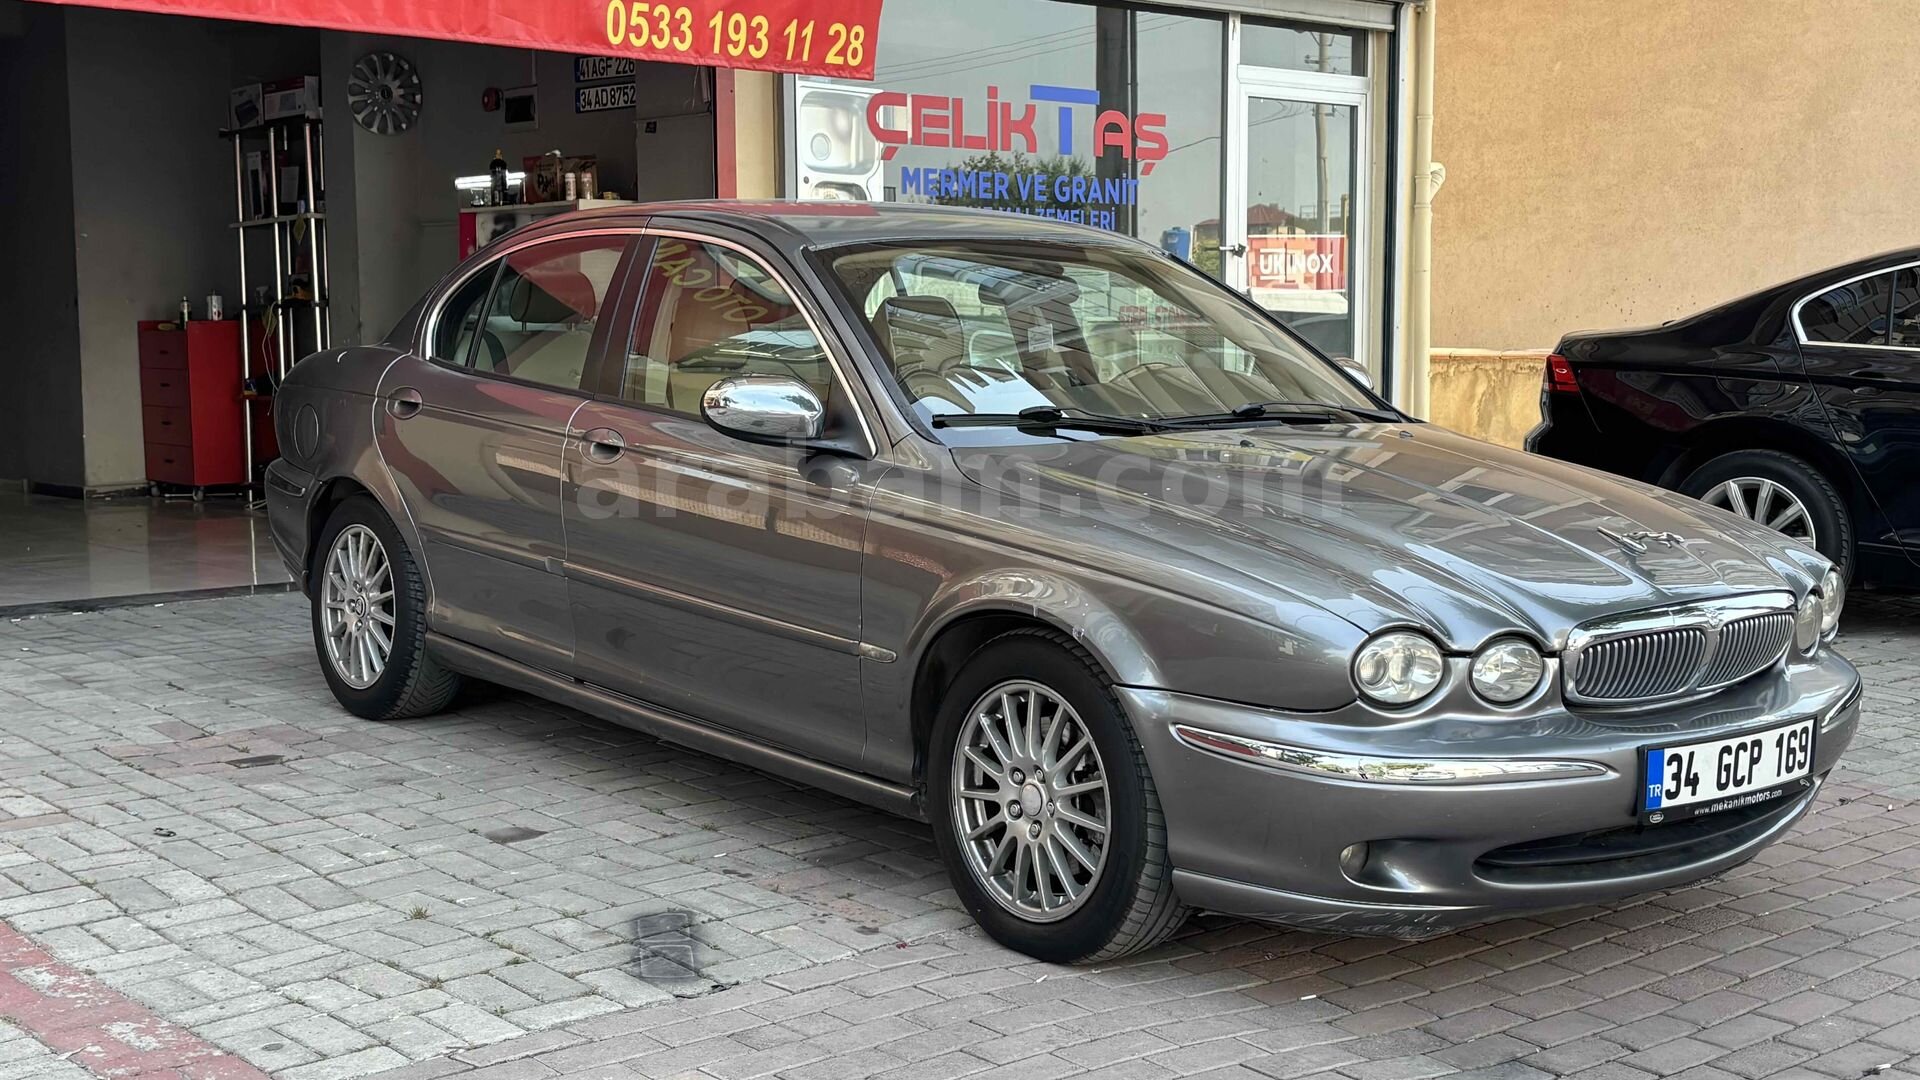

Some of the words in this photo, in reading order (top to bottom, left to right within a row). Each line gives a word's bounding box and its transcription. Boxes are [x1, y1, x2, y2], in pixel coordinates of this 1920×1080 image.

[606, 0, 693, 51] 0533
[708, 10, 769, 59] 193
[783, 19, 815, 61] 11
[825, 23, 865, 66] 28
[610, 85, 636, 106] 8752
[901, 166, 1009, 200] MERMER
[1016, 175, 1047, 202] VE
[1054, 172, 1139, 206] GRANİT
[1665, 751, 1700, 800] 34
[1716, 739, 1763, 791] GCP
[1775, 726, 1810, 777] 169
[1648, 783, 1662, 798] TR
[1694, 789, 1782, 816] www.mekanikmotors.com
